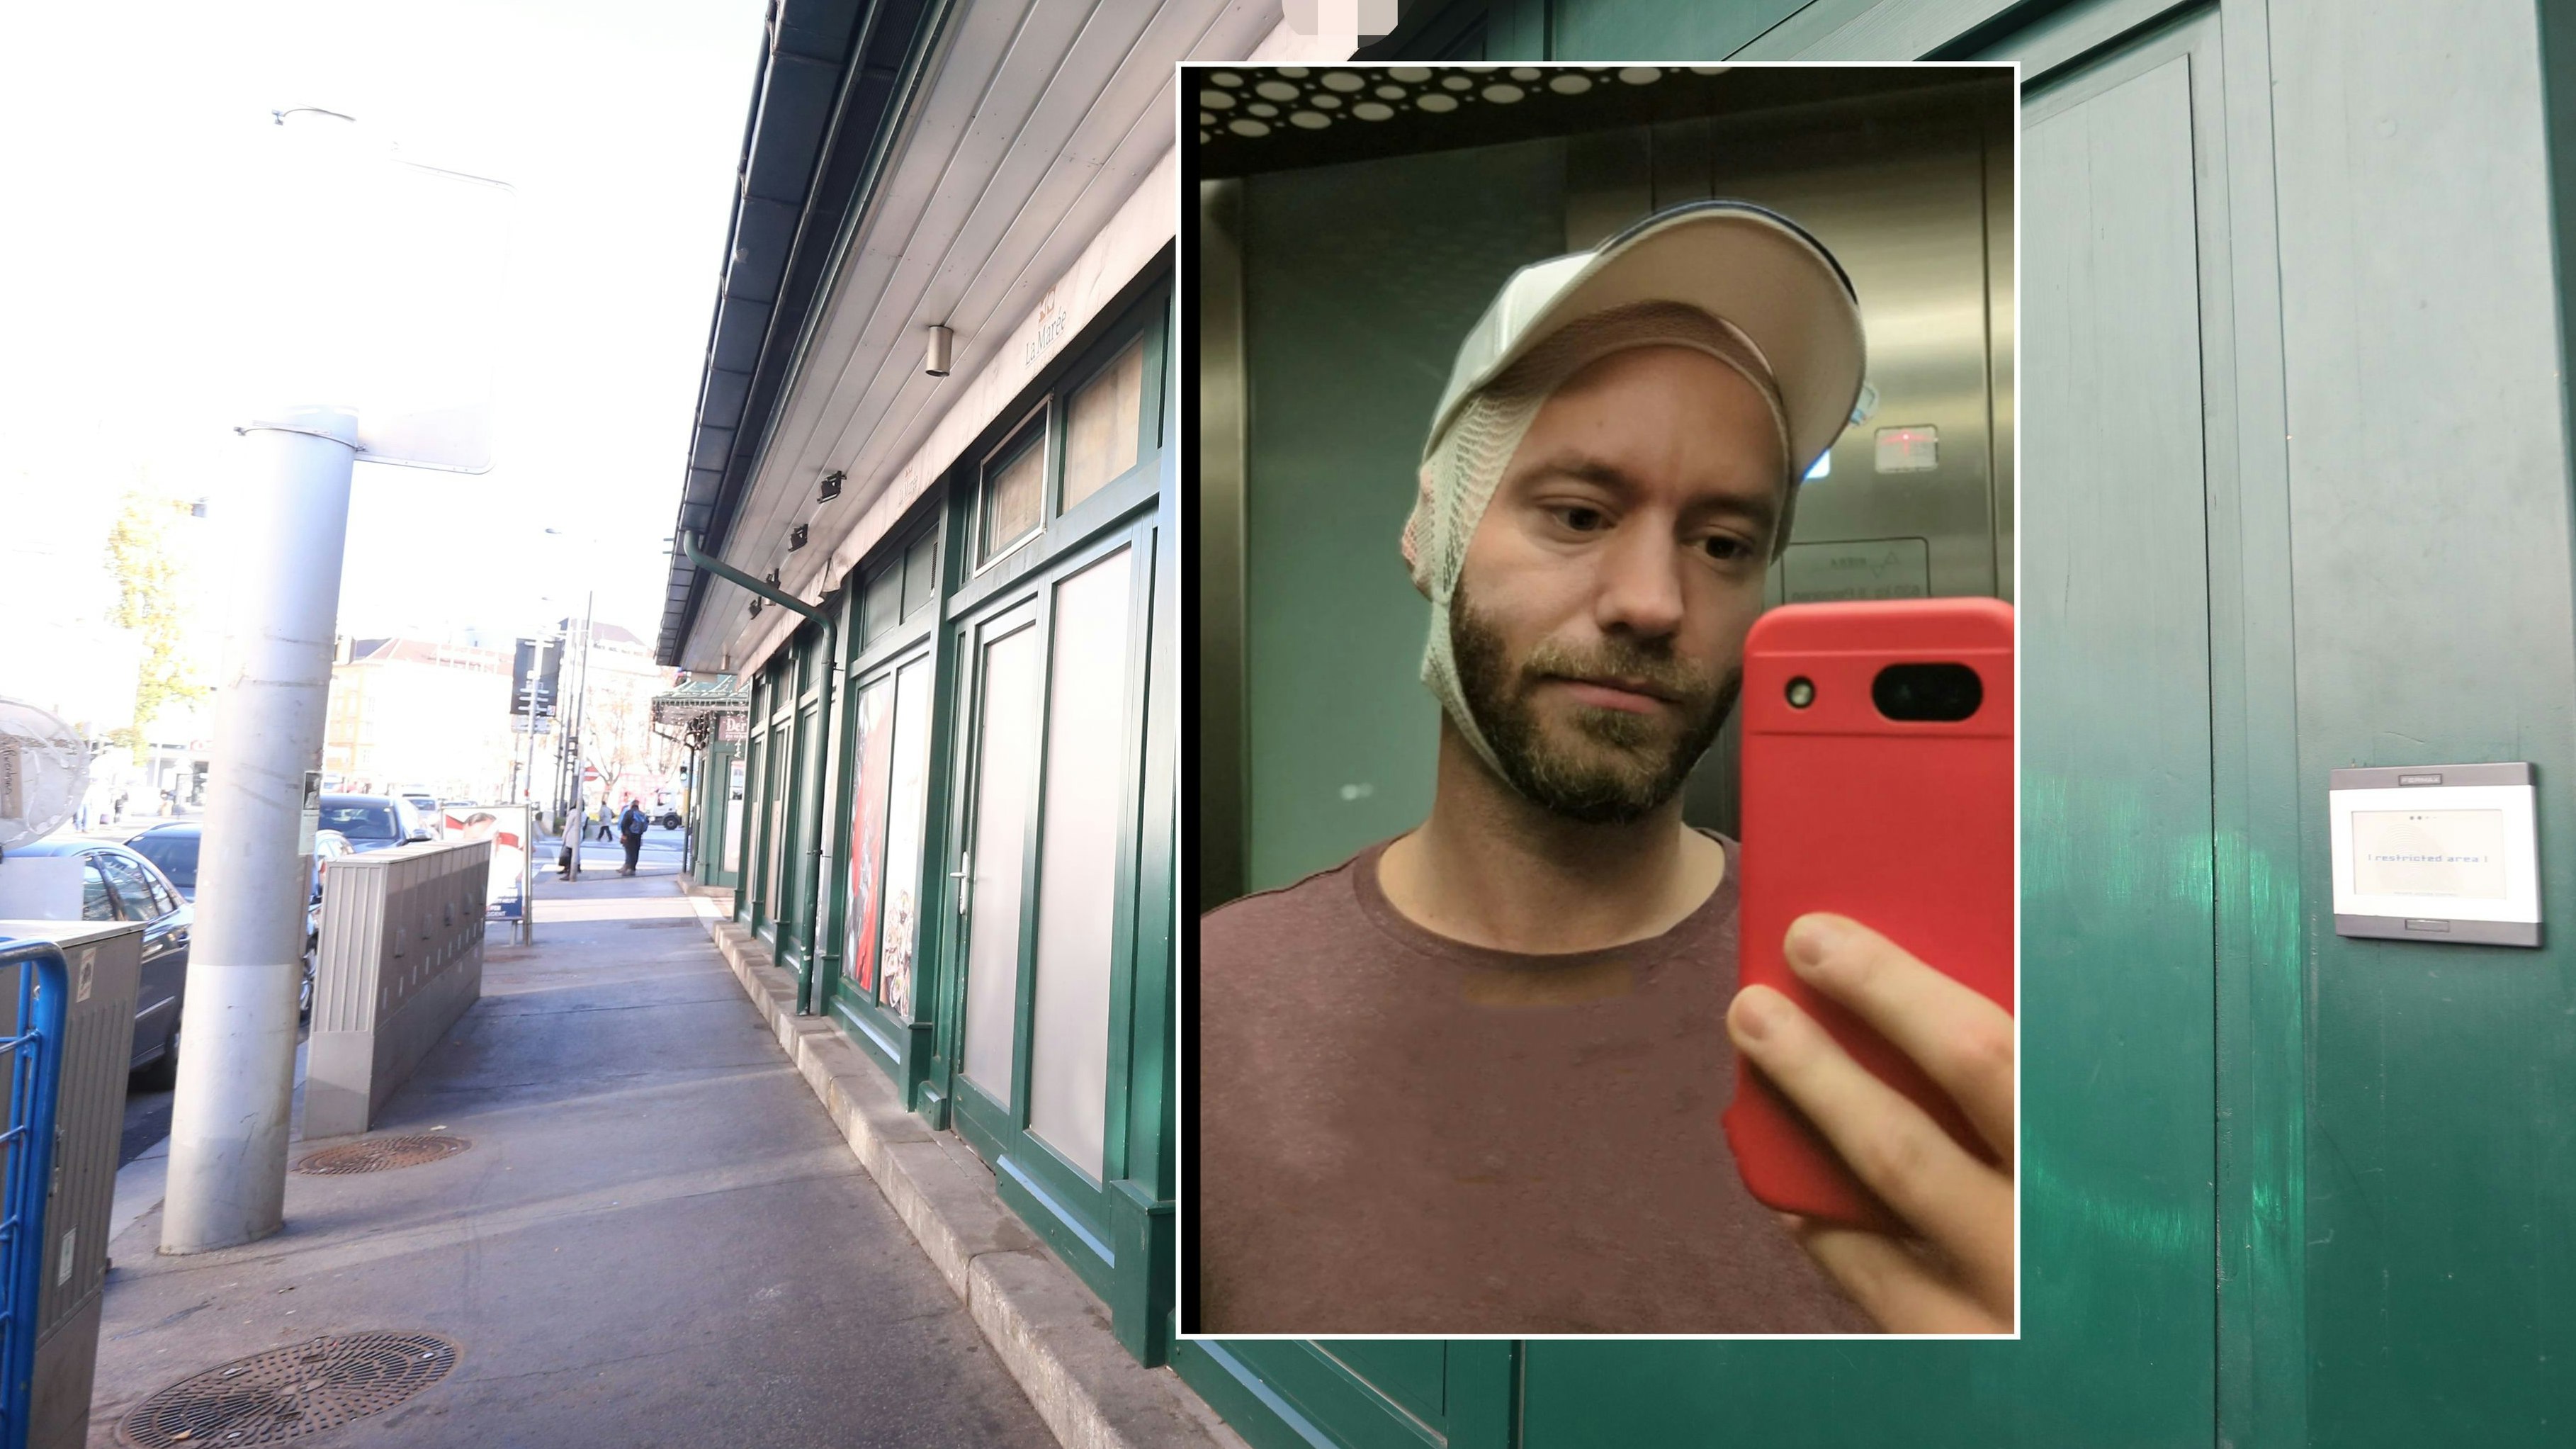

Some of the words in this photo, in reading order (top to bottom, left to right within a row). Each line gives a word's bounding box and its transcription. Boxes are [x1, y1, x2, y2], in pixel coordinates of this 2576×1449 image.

[1025, 342, 1035, 365] La
[1036, 306, 1067, 354] Marée
[2375, 854, 2443, 862] restricted
